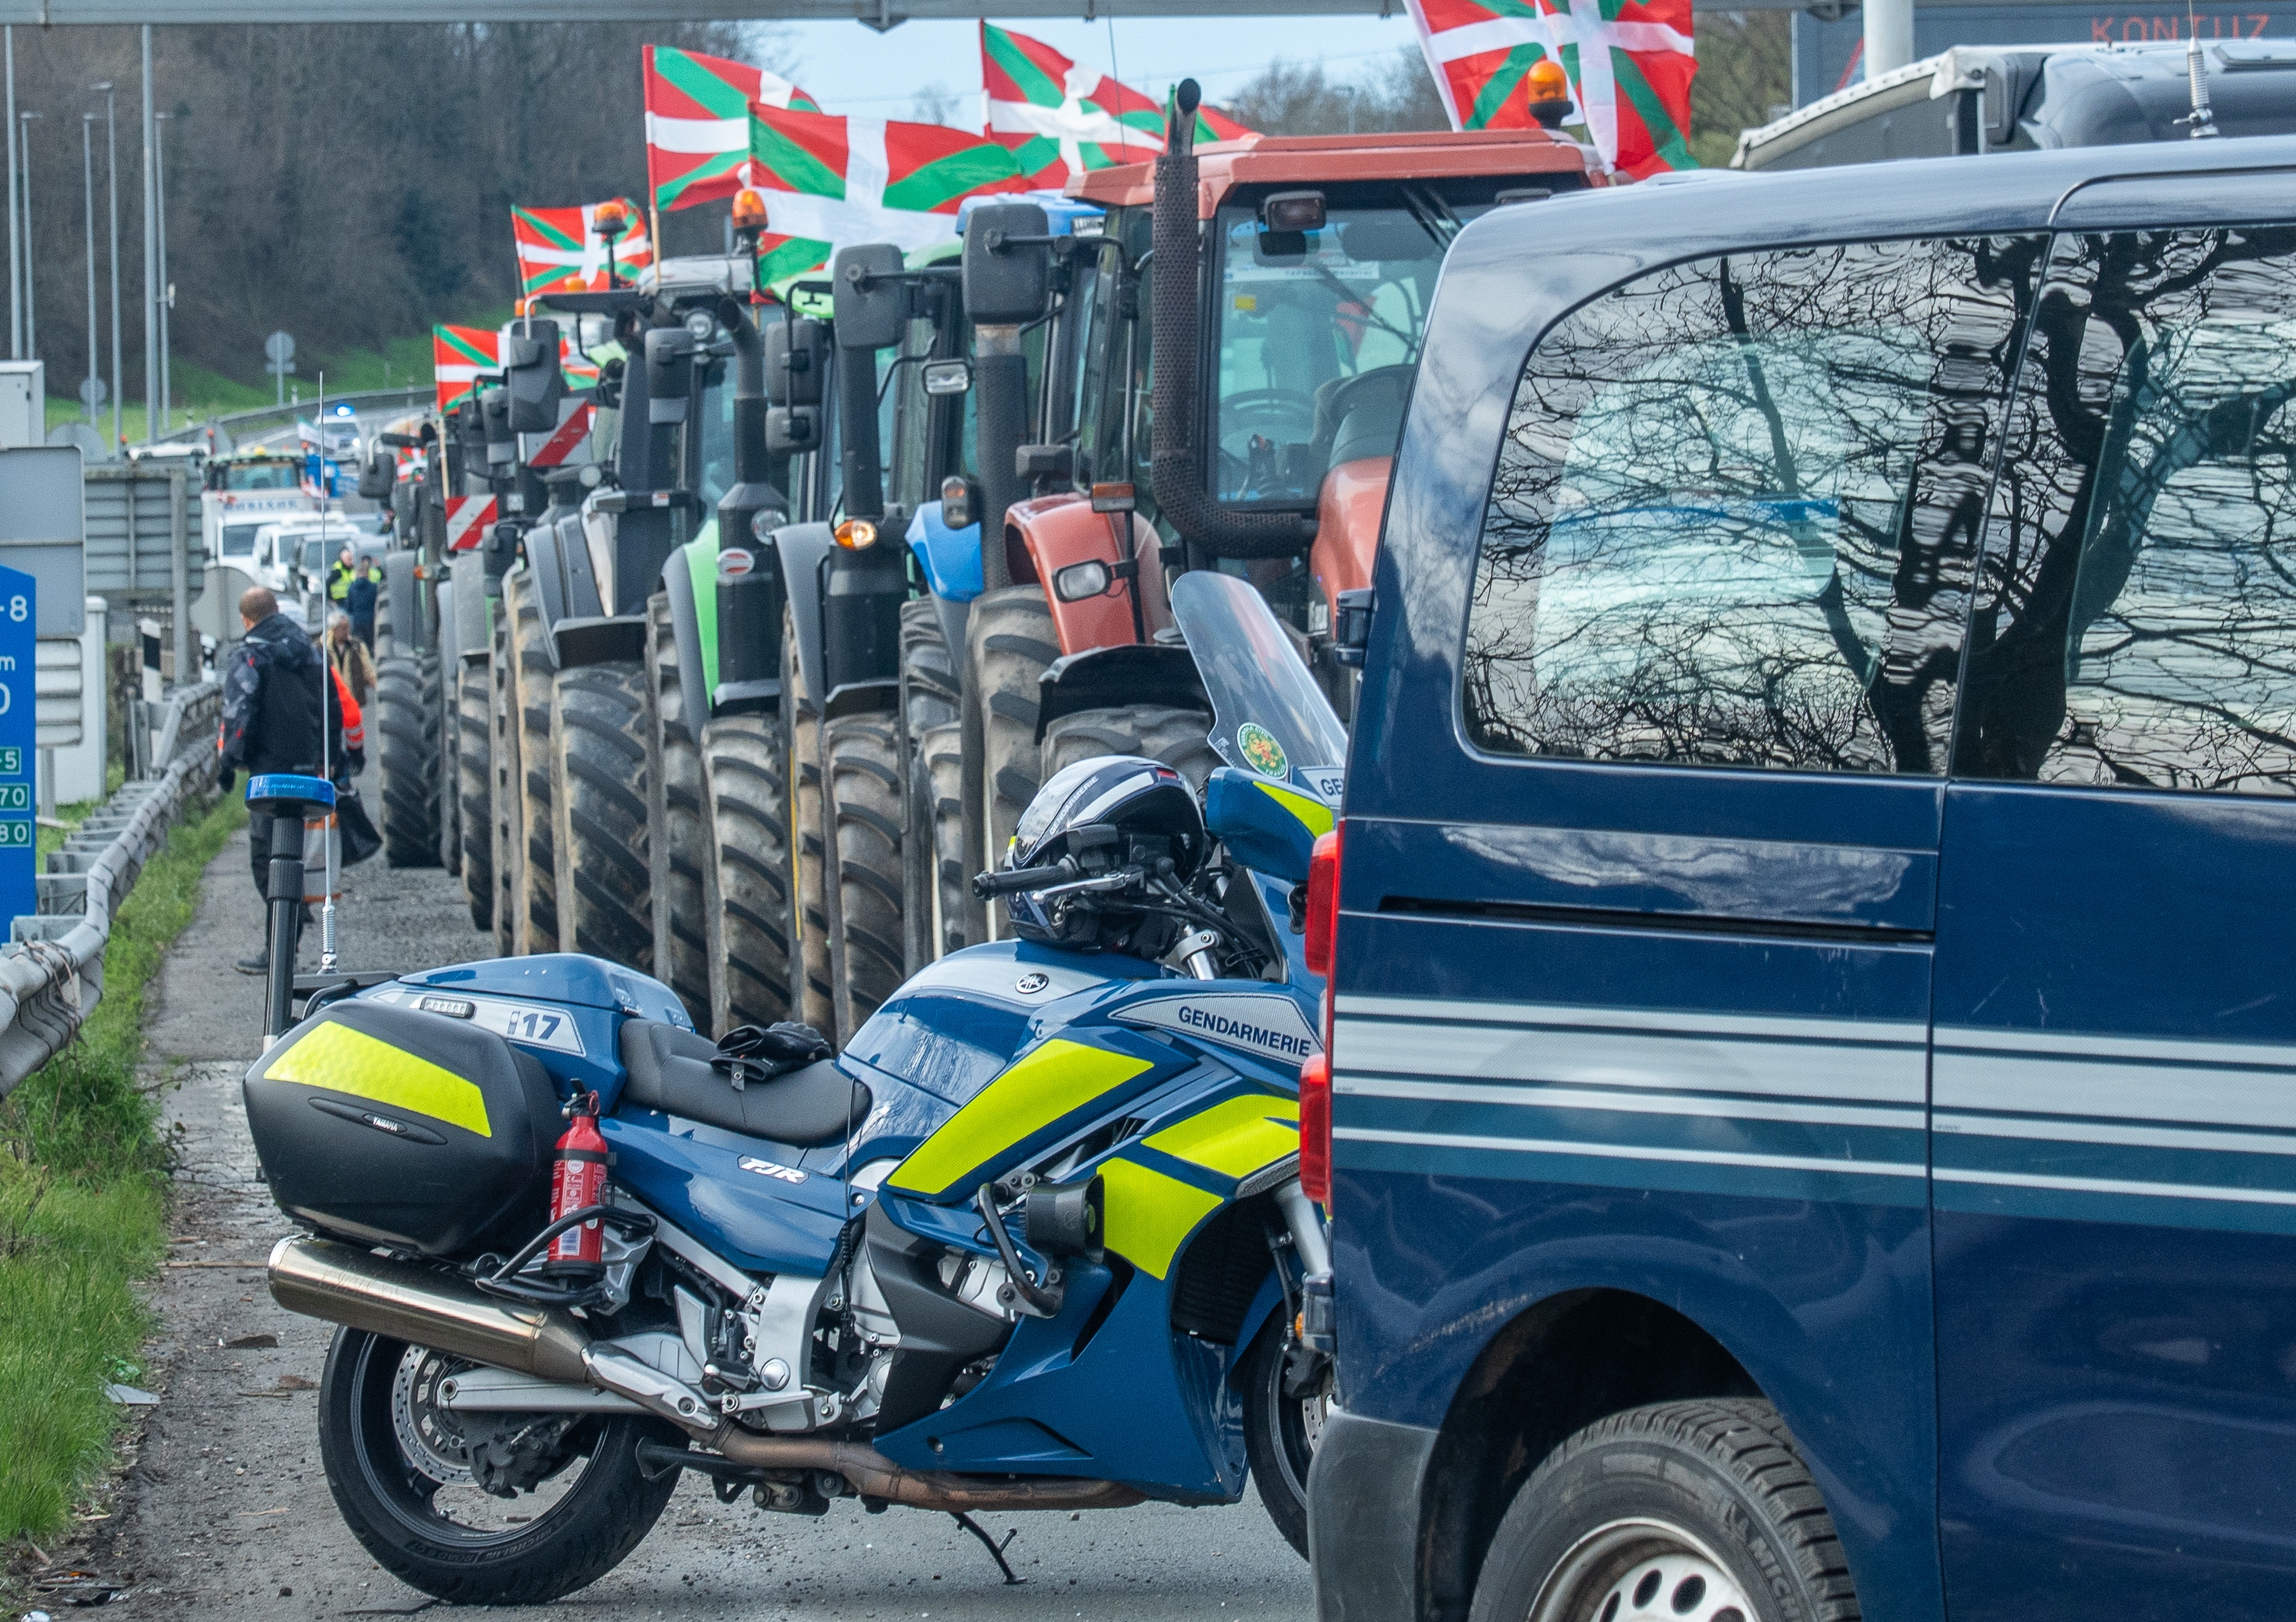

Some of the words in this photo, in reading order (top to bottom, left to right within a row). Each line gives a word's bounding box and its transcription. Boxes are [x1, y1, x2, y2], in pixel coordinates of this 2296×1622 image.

[1179, 1006, 1312, 1057] GENDARMERIE
[372, 1115, 398, 1133] YAMAHA
[741, 1157, 805, 1183] FJR
